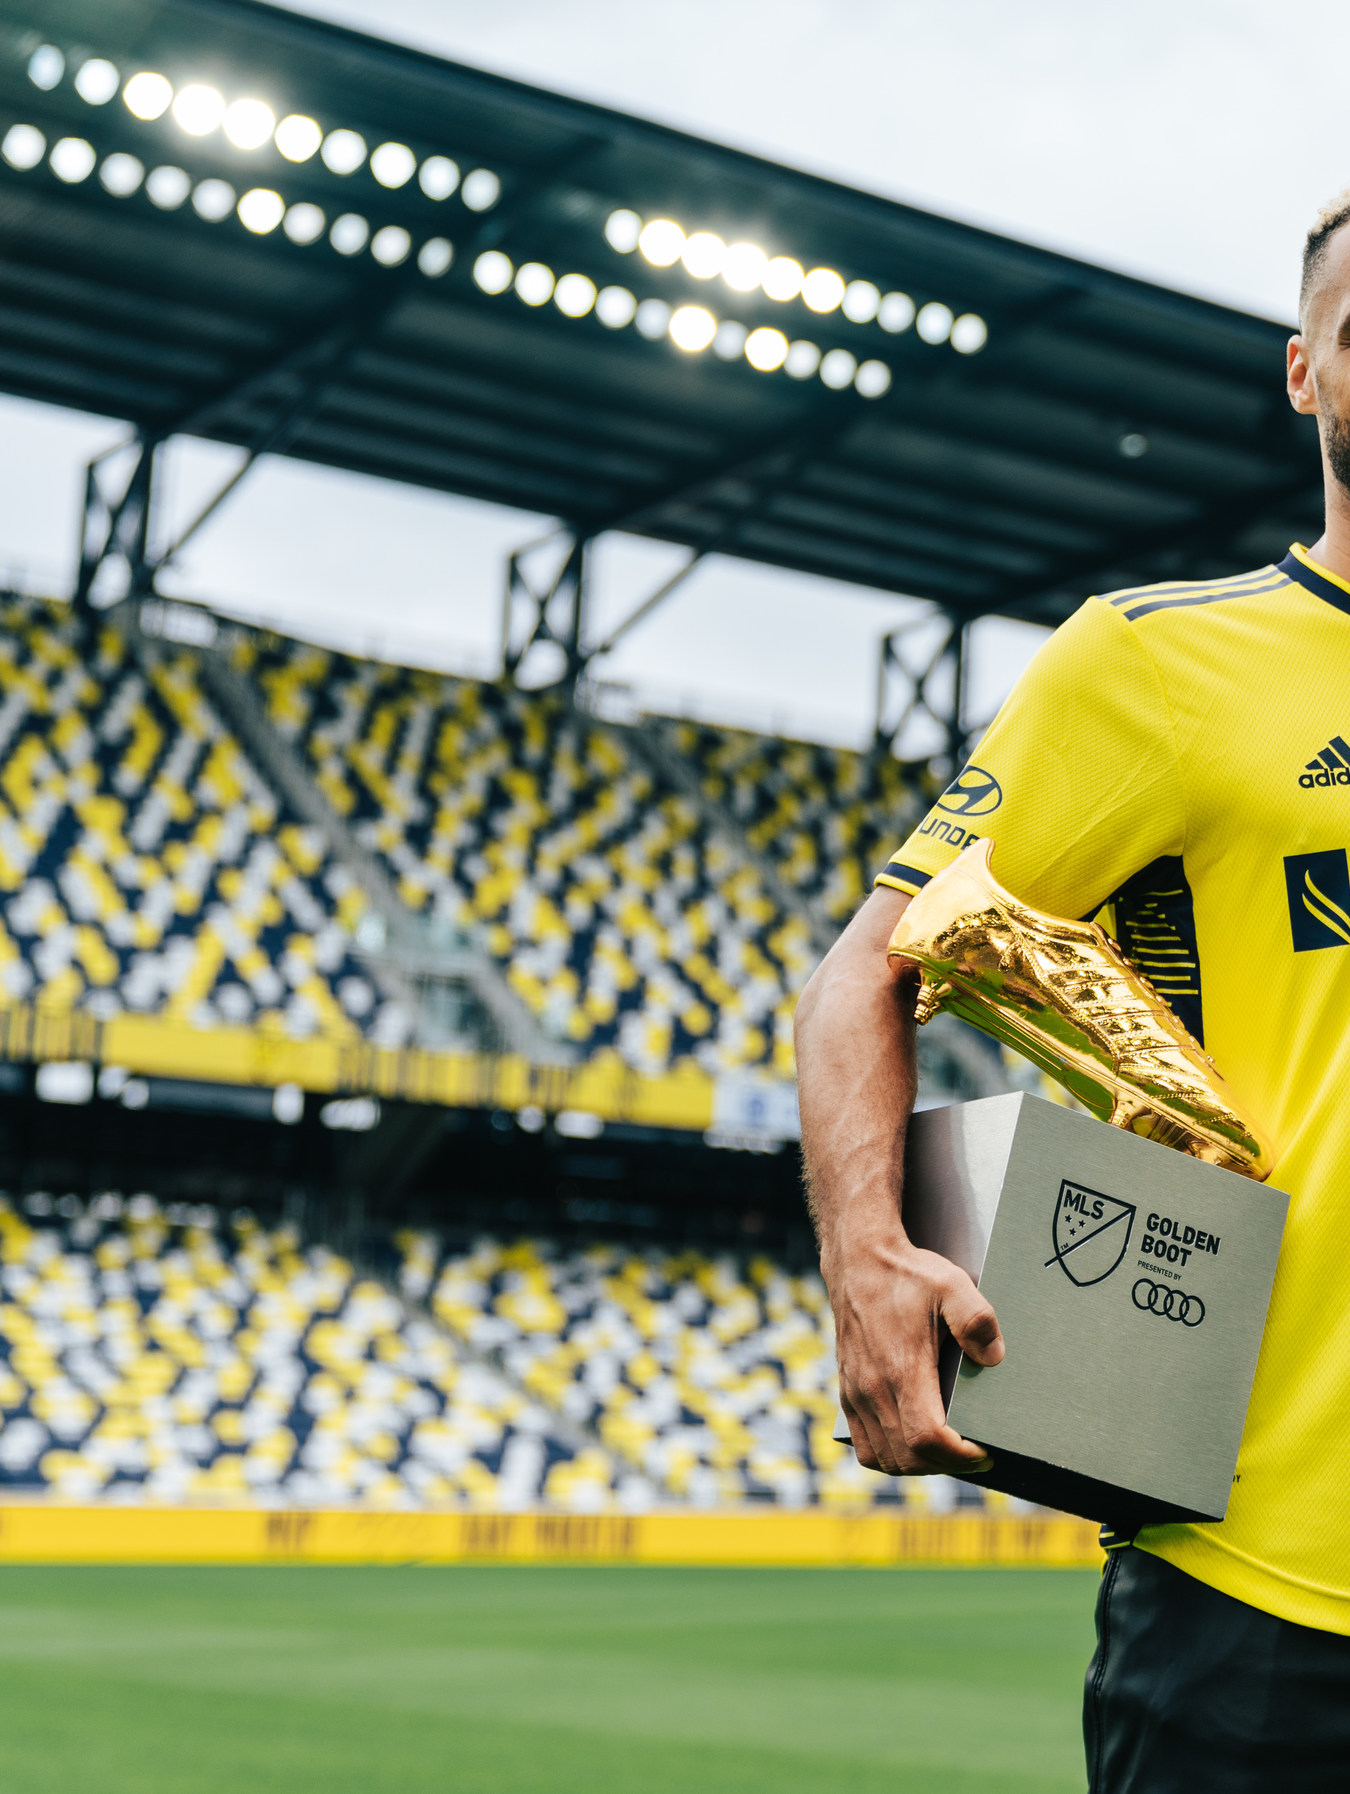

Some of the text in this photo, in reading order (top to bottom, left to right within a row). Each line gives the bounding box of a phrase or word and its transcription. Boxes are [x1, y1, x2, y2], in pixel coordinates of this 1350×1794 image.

[1063, 1189, 1104, 1220] MLS
[1146, 1213, 1221, 1255] GOLDEN
[1141, 1234, 1192, 1267] BOOT
[1137, 1260, 1182, 1281] PRESENTED BY
